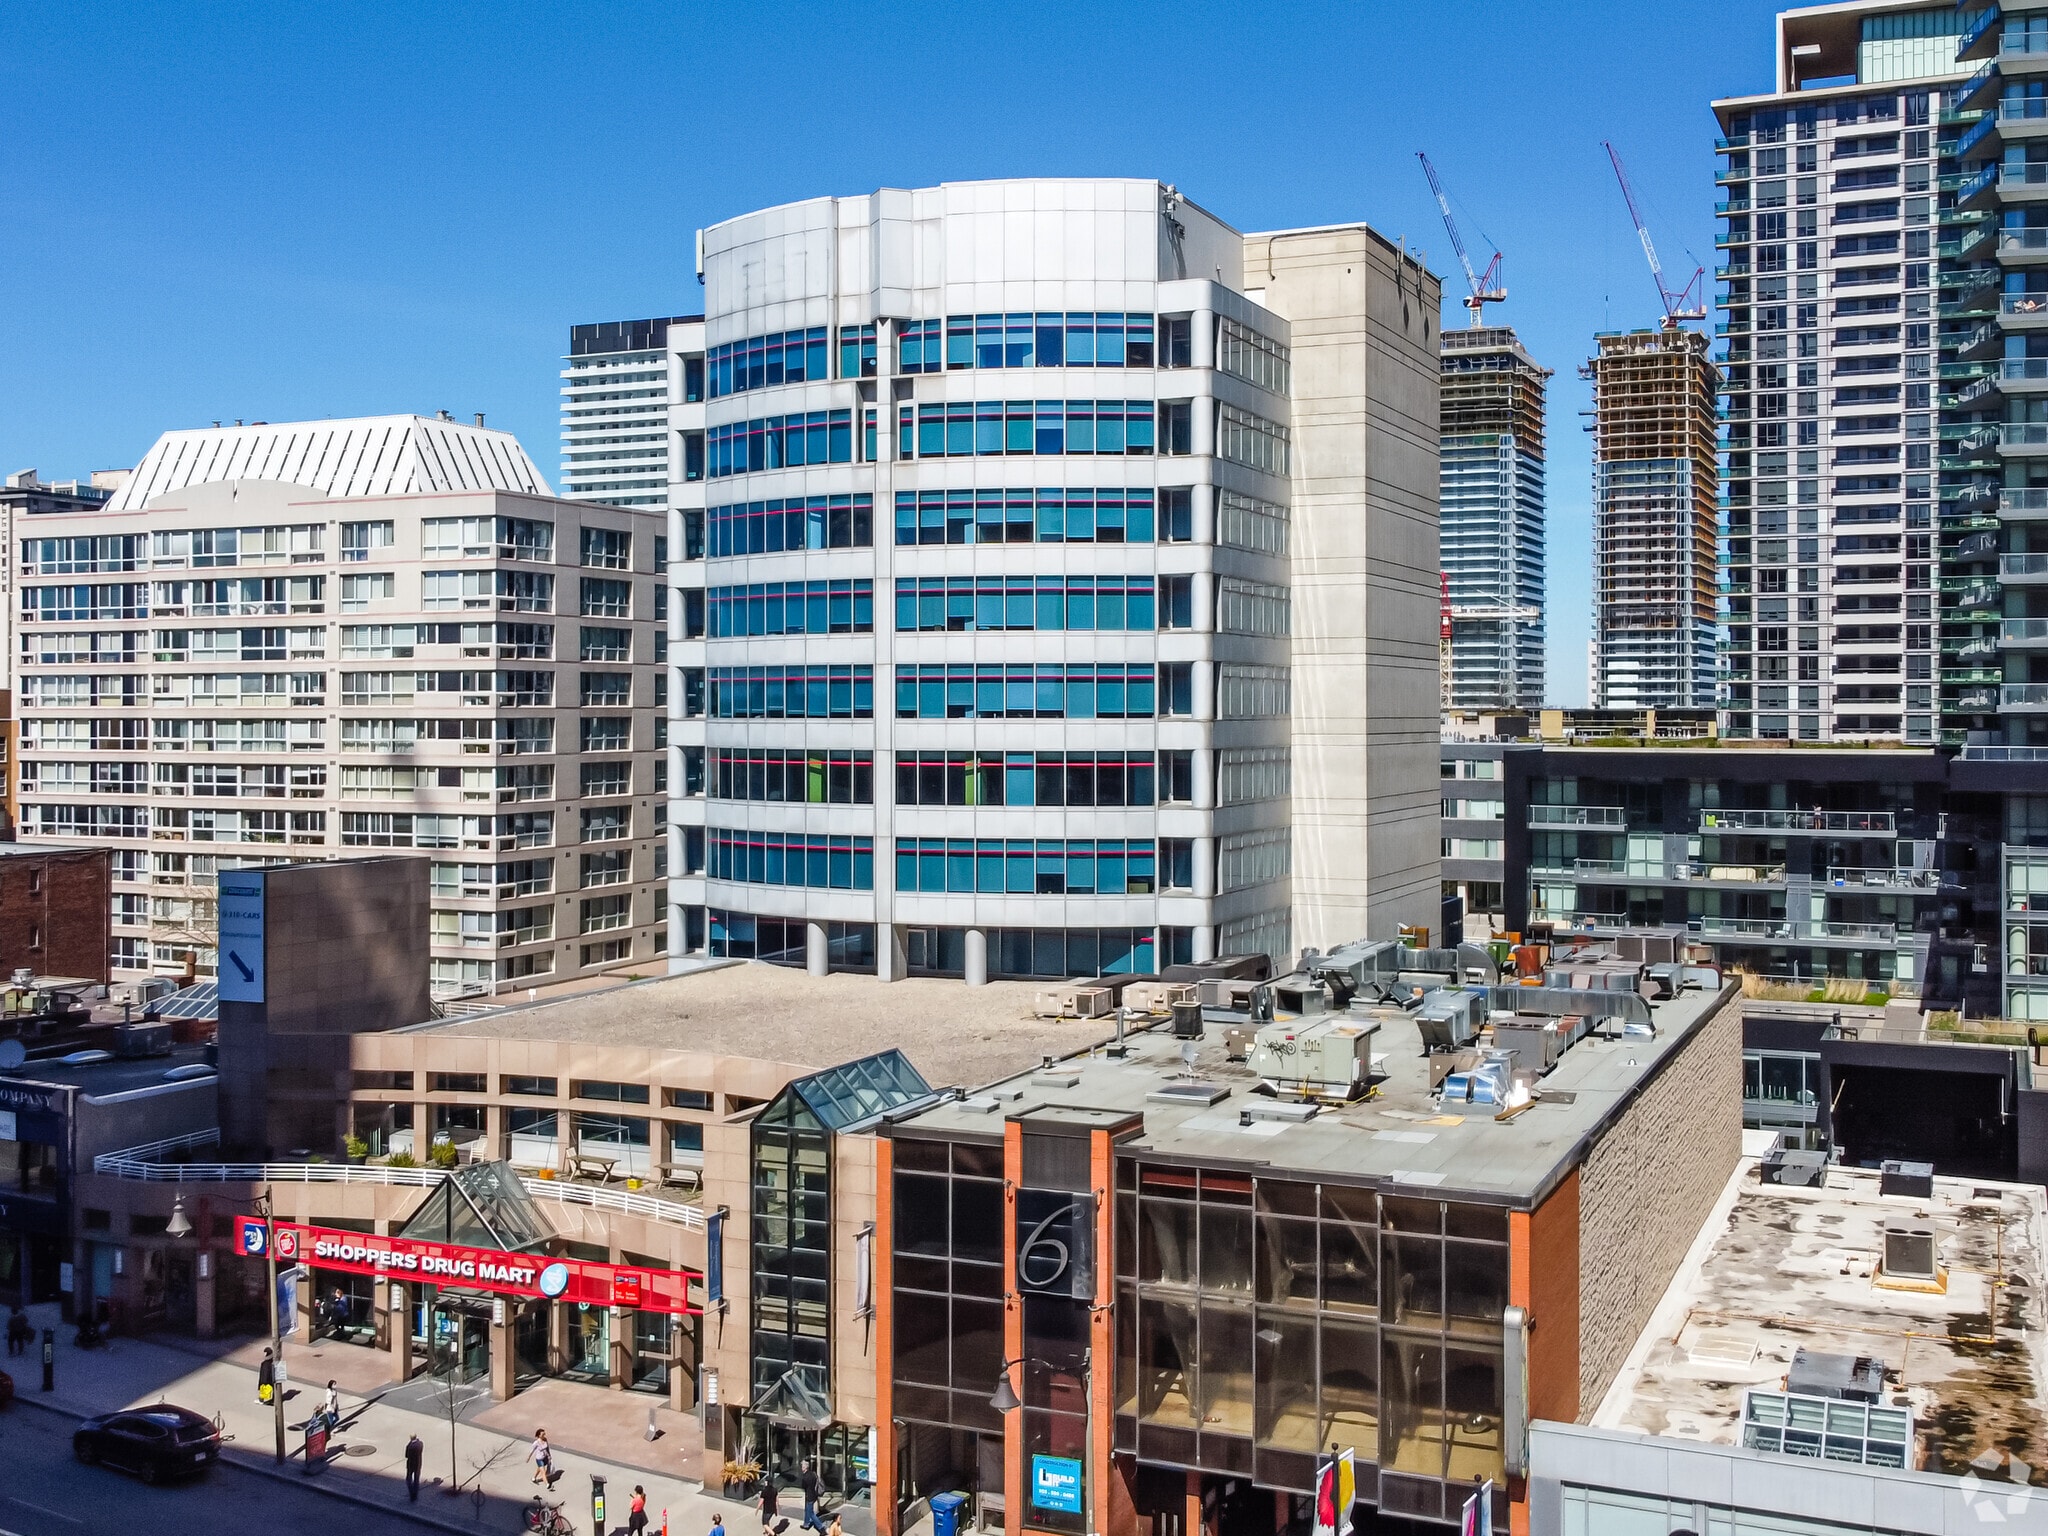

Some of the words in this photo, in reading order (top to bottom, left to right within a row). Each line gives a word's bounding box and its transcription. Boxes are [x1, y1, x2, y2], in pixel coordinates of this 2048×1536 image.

[315, 1241, 417, 1269] SHOPPERS
[421, 1256, 475, 1277] DRUG
[479, 1264, 536, 1284] MART
[1019, 1203, 1085, 1285] 6
